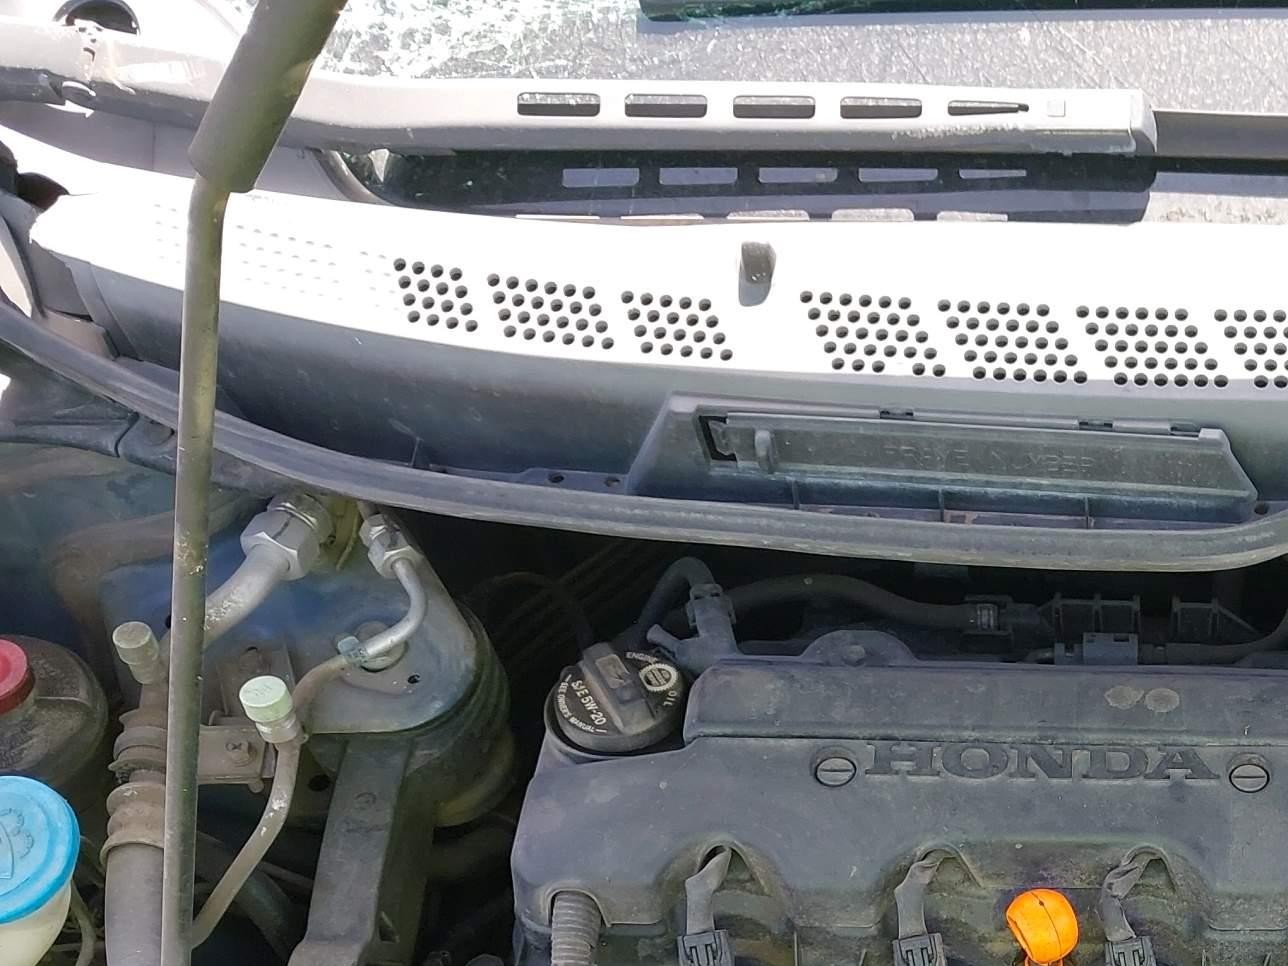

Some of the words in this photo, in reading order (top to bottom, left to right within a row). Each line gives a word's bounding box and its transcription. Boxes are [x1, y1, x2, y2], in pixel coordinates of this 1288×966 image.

[581, 694, 606, 725] 5W-20
[662, 690, 677, 706] OIL
[569, 716, 594, 733] MANUAL
[865, 743, 1221, 782] HONDA
